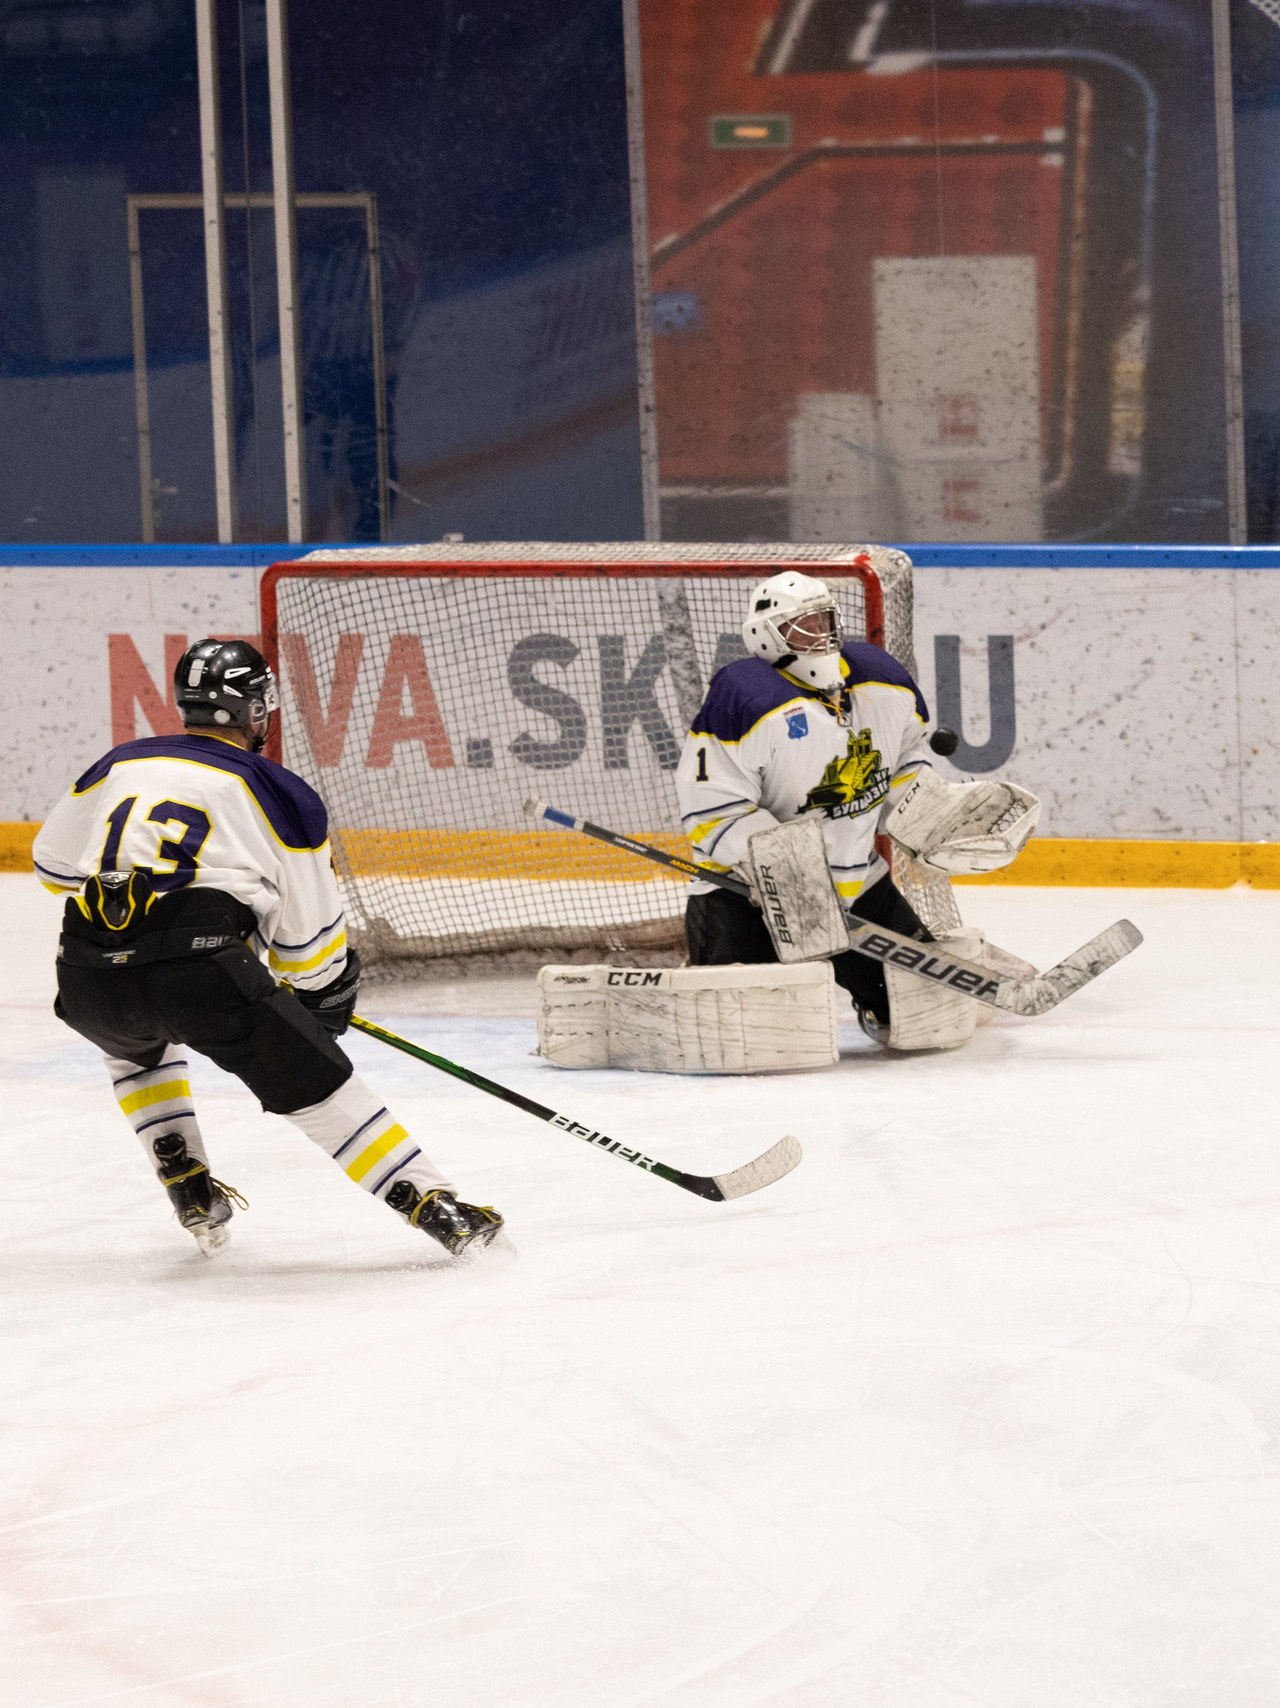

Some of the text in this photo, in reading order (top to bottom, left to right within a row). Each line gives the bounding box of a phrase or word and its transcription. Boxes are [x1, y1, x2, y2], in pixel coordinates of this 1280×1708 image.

[695, 747, 709, 782] 1
[101, 795, 212, 893] 13
[607, 972, 663, 986] CCM
